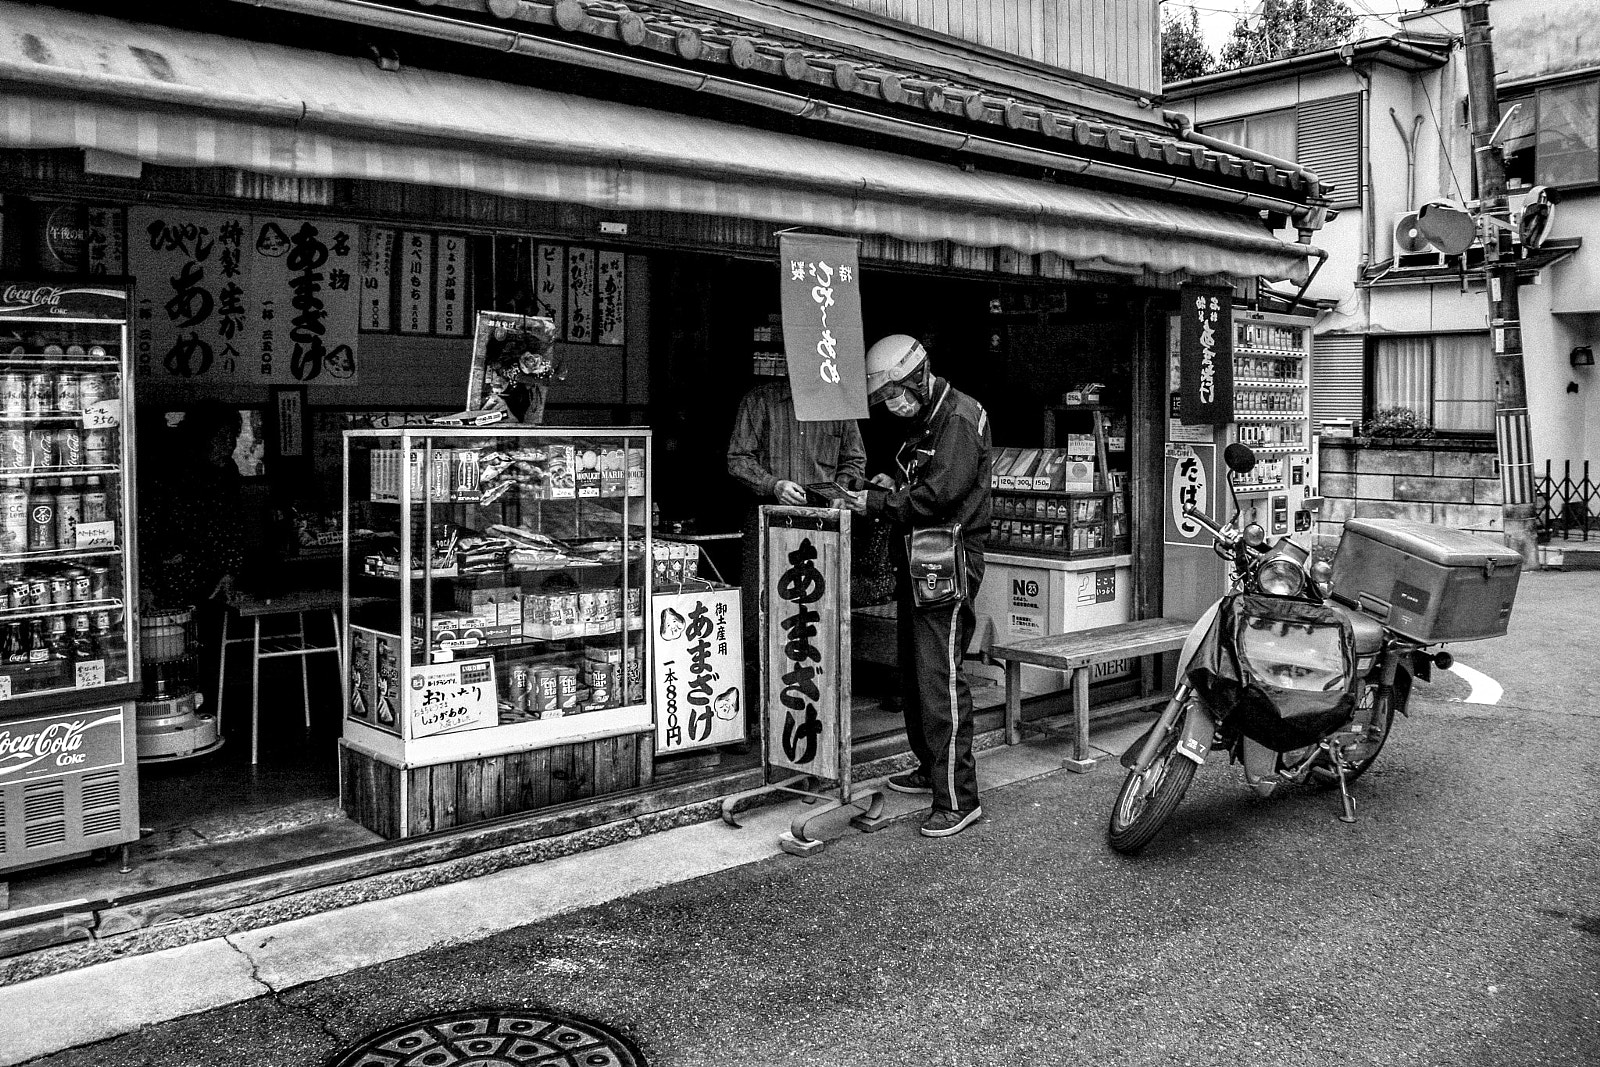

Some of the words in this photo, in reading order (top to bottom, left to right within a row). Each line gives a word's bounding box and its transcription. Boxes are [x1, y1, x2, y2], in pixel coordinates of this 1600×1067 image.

[329, 231, 350, 290] 名物
[411, 236, 423, 300] あべ川もち
[543, 247, 556, 293] ビール
[3, 284, 60, 306] Coca-Cola
[50, 306, 68, 315] Coke
[287, 222, 328, 381] あまざけ
[85, 407, 109, 415] ビール
[601, 470, 624, 479] MARIE
[1096, 586, 1115, 596] いっぷく
[715, 602, 728, 656] 御土産用
[777, 537, 825, 765] あまざけ
[685, 600, 719, 742] あまざけ
[421, 706, 468, 725] しょうがあめ
[662, 659, 682, 747] 一本880円
[56, 753, 86, 766] Coke
